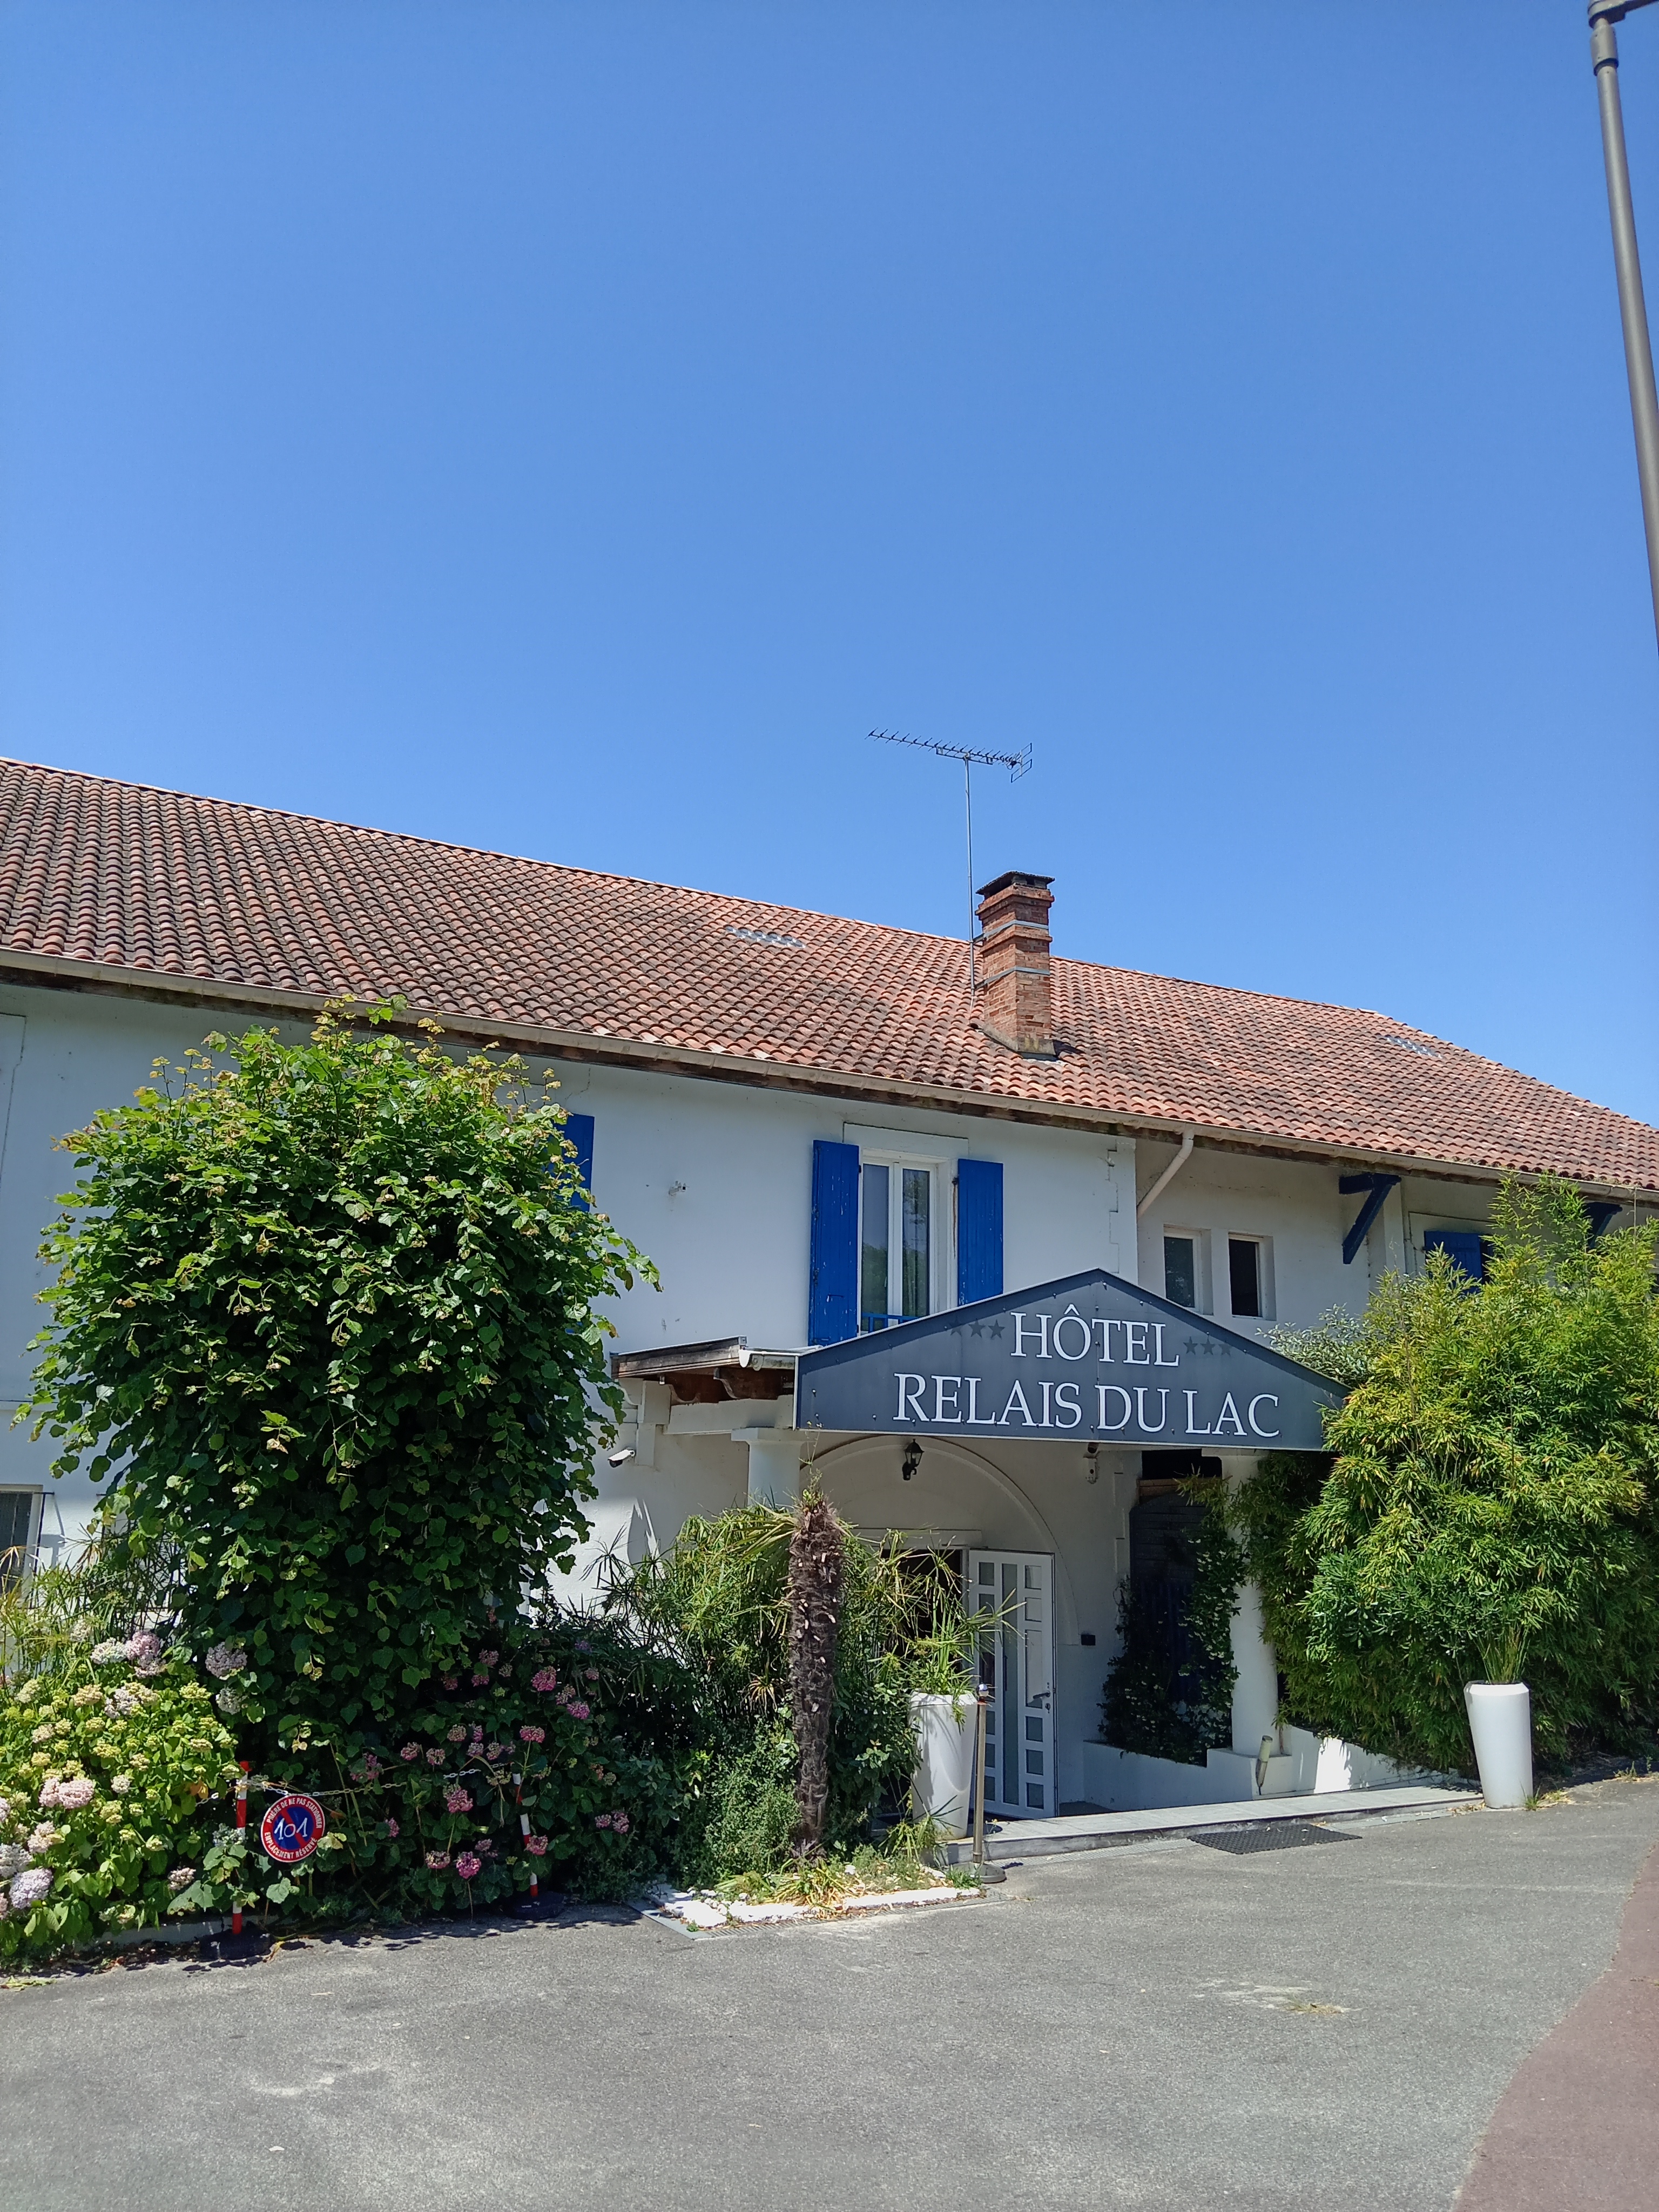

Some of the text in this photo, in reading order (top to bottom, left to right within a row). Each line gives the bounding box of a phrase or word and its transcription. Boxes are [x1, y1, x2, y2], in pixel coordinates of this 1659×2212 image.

[1010, 1304, 1179, 1366] HÔTEL
[893, 1373, 1280, 1437] RELAIS DU LAC
[266, 1805, 282, 1824] PRIÈRE
[280, 1799, 288, 1809] DE
[296, 1797, 306, 1805] PAS
[274, 1817, 308, 1840] 101
[264, 1832, 294, 1859] EMPLACEMENT
